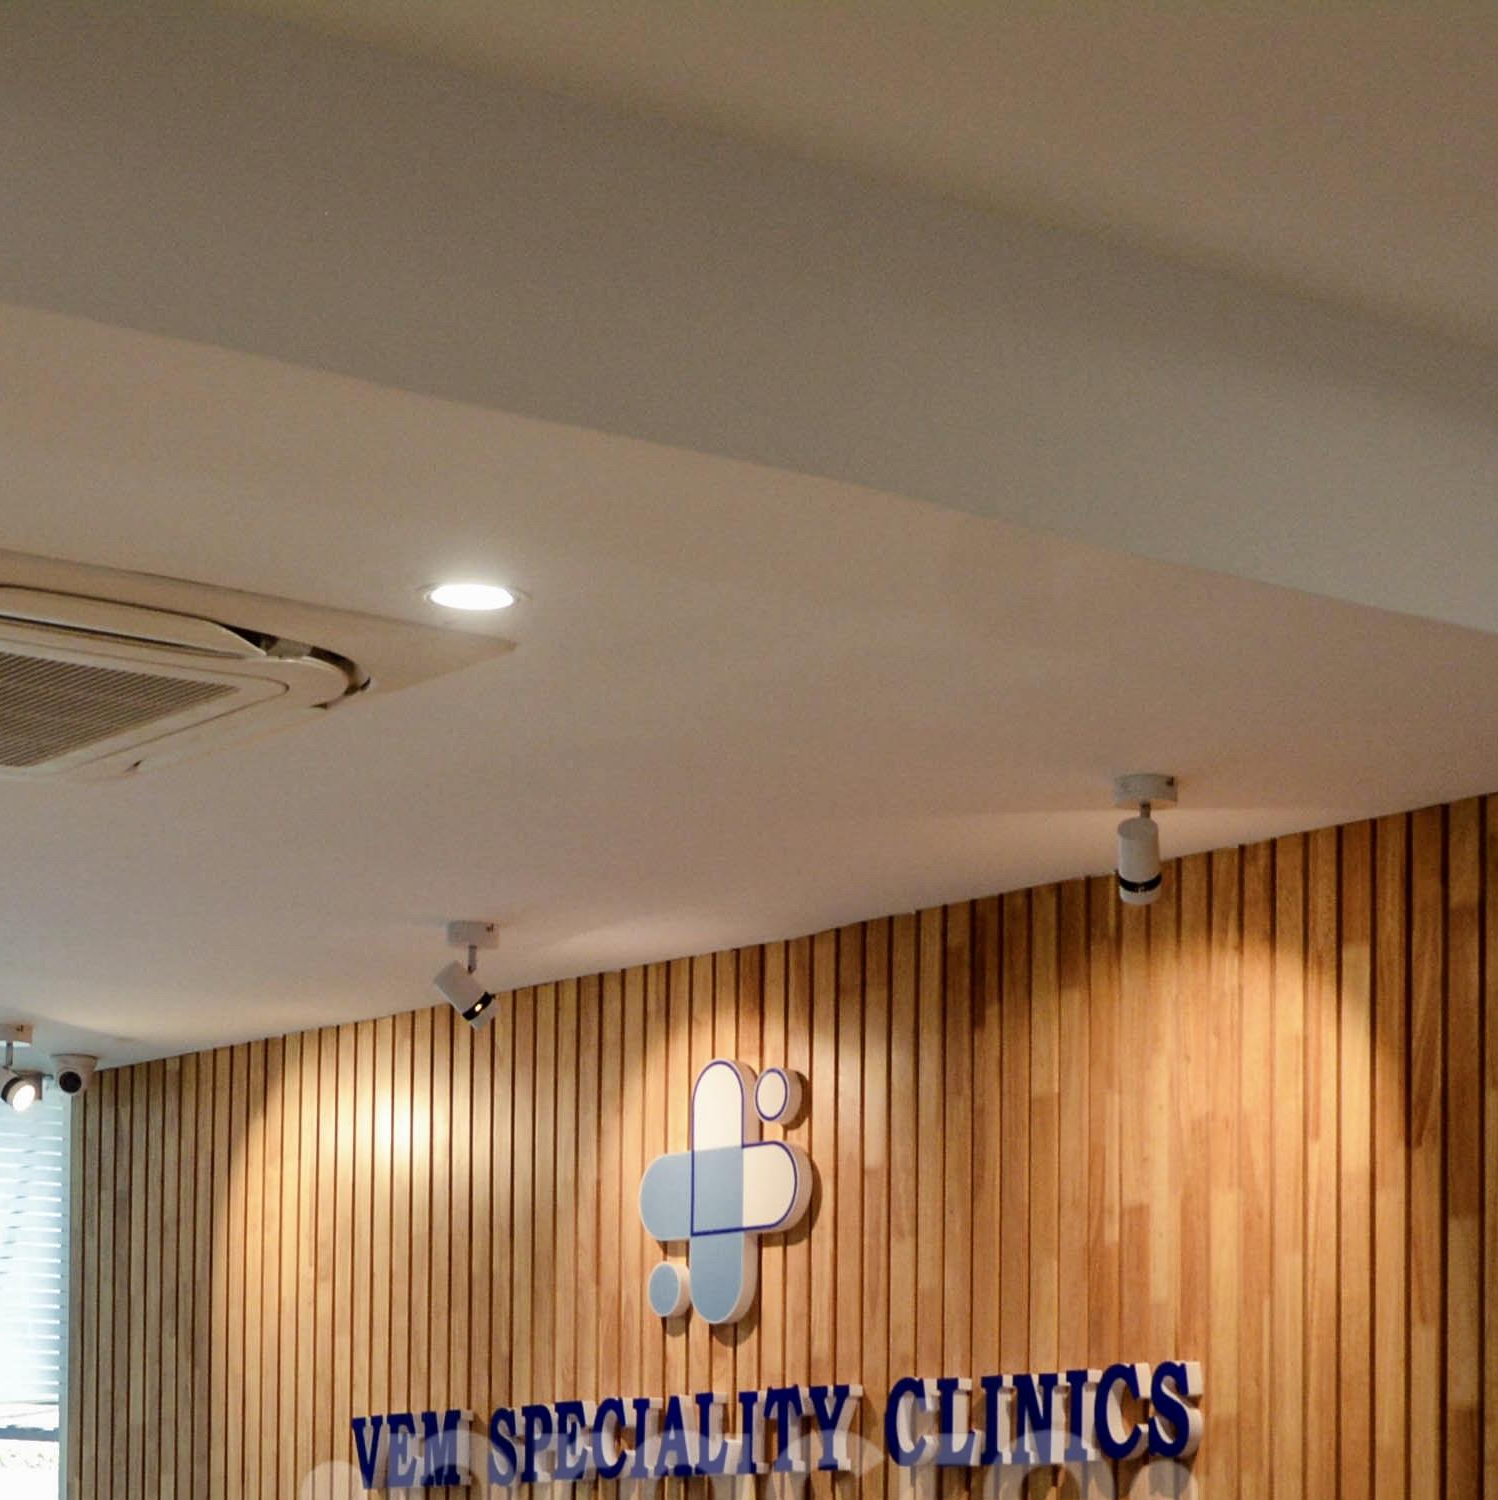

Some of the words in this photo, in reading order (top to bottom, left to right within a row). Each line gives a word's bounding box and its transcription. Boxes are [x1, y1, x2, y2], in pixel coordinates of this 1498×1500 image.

[352, 1409, 471, 1490] VEM
[487, 1384, 859, 1487] SPECIALITY
[884, 1360, 1201, 1468] CLINICS
